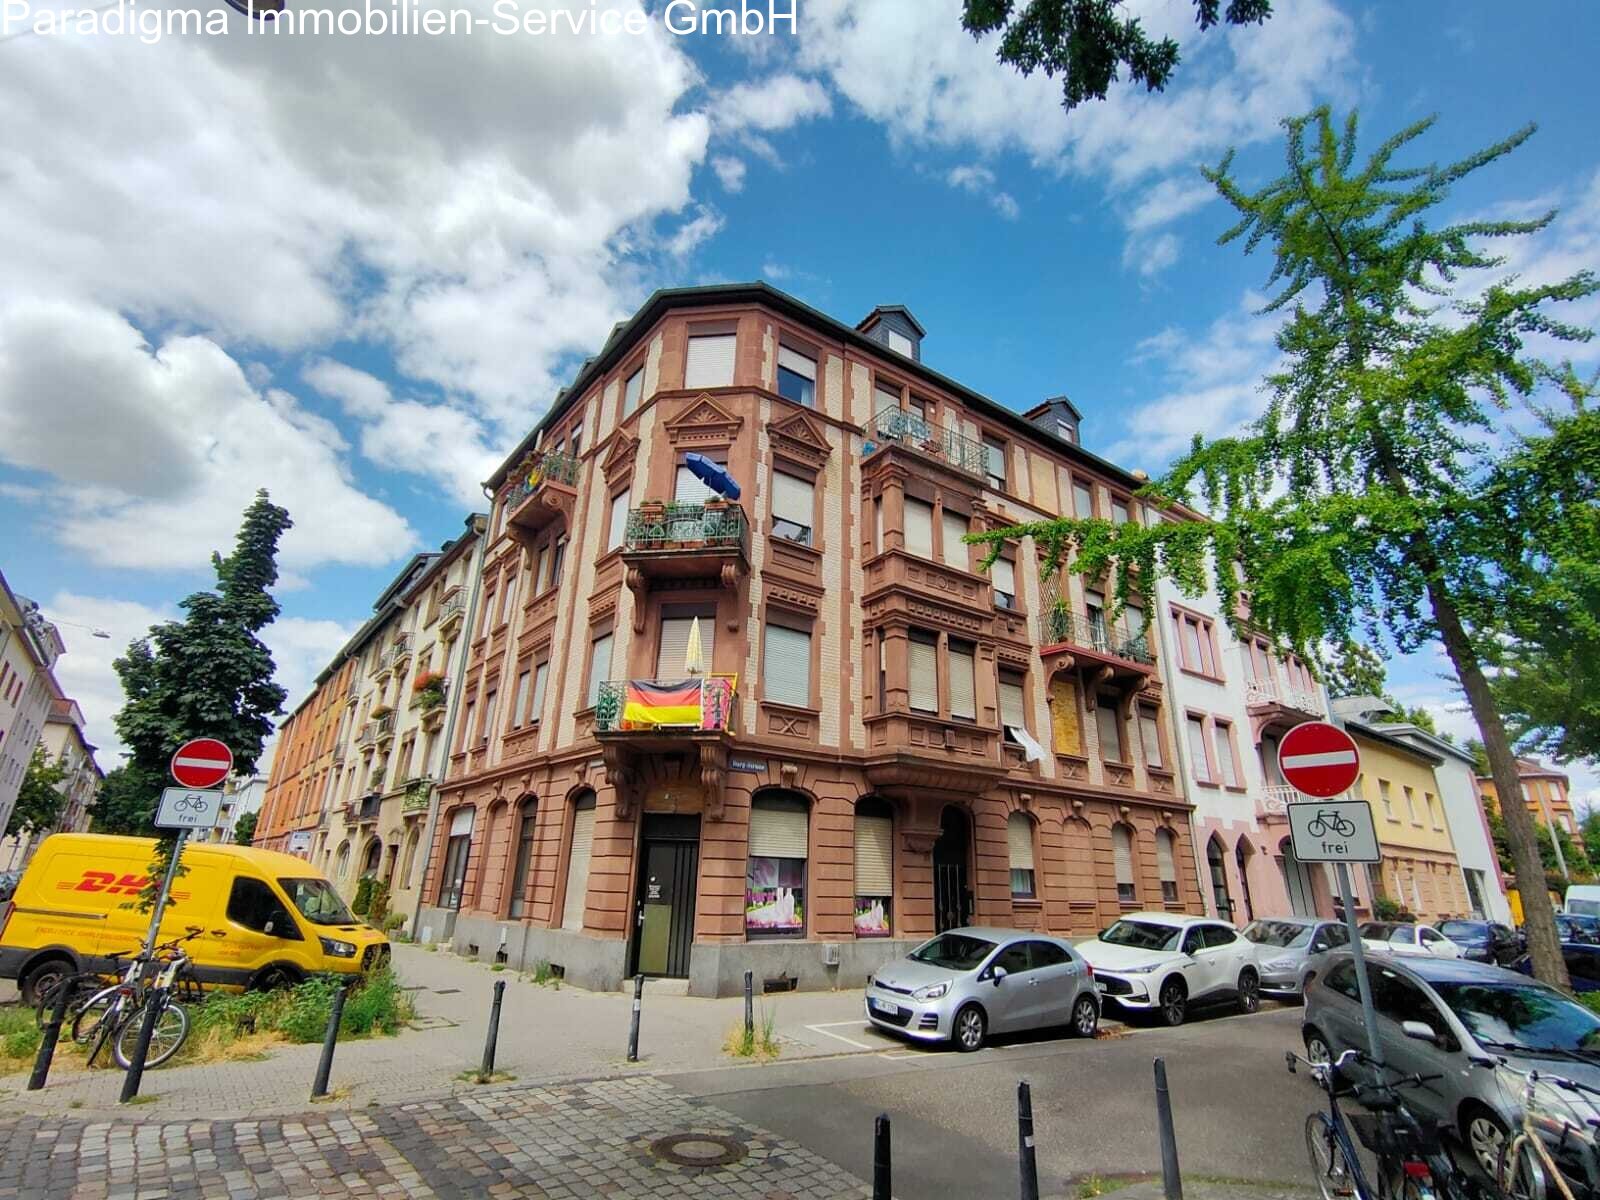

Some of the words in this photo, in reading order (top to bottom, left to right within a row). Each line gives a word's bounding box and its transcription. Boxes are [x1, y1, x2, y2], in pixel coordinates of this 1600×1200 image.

[179, 814, 198, 823] frei
[1321, 840, 1349, 854] frei
[74, 870, 168, 898] DH
